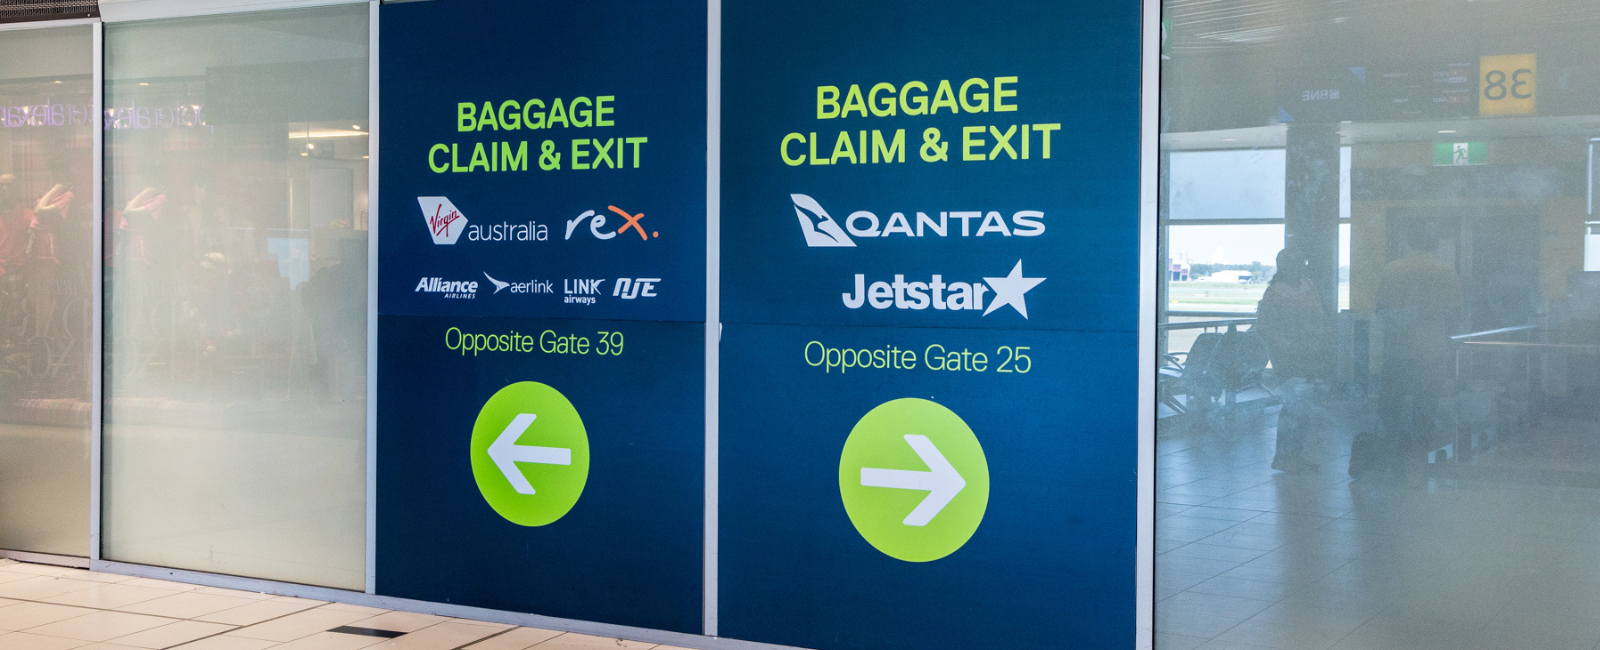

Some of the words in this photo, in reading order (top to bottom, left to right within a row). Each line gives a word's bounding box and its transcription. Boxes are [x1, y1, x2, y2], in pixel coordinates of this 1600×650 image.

[817, 76, 1018, 119] BAGGAGE
[458, 96, 614, 132] BAGGAGE
[429, 141, 527, 173] CLAIM
[539, 140, 561, 170] &
[572, 137, 647, 169] EXIT
[781, 129, 905, 166] CLAIM
[920, 128, 948, 162] &
[963, 123, 1061, 161] EXIT
[429, 203, 461, 238] Virgin
[468, 220, 548, 241] australia
[845, 210, 1046, 237] QANTAS
[415, 277, 479, 293] Alliance
[511, 280, 553, 293] aerlink
[564, 278, 606, 296] LINK
[564, 294, 597, 306] airways
[842, 274, 988, 310] Jetstar
[445, 327, 534, 357] Opposite
[540, 330, 589, 354] Gate
[596, 332, 623, 355] 39
[805, 341, 916, 373] Opposite
[925, 344, 988, 372] Gate
[996, 346, 1032, 373] 25
